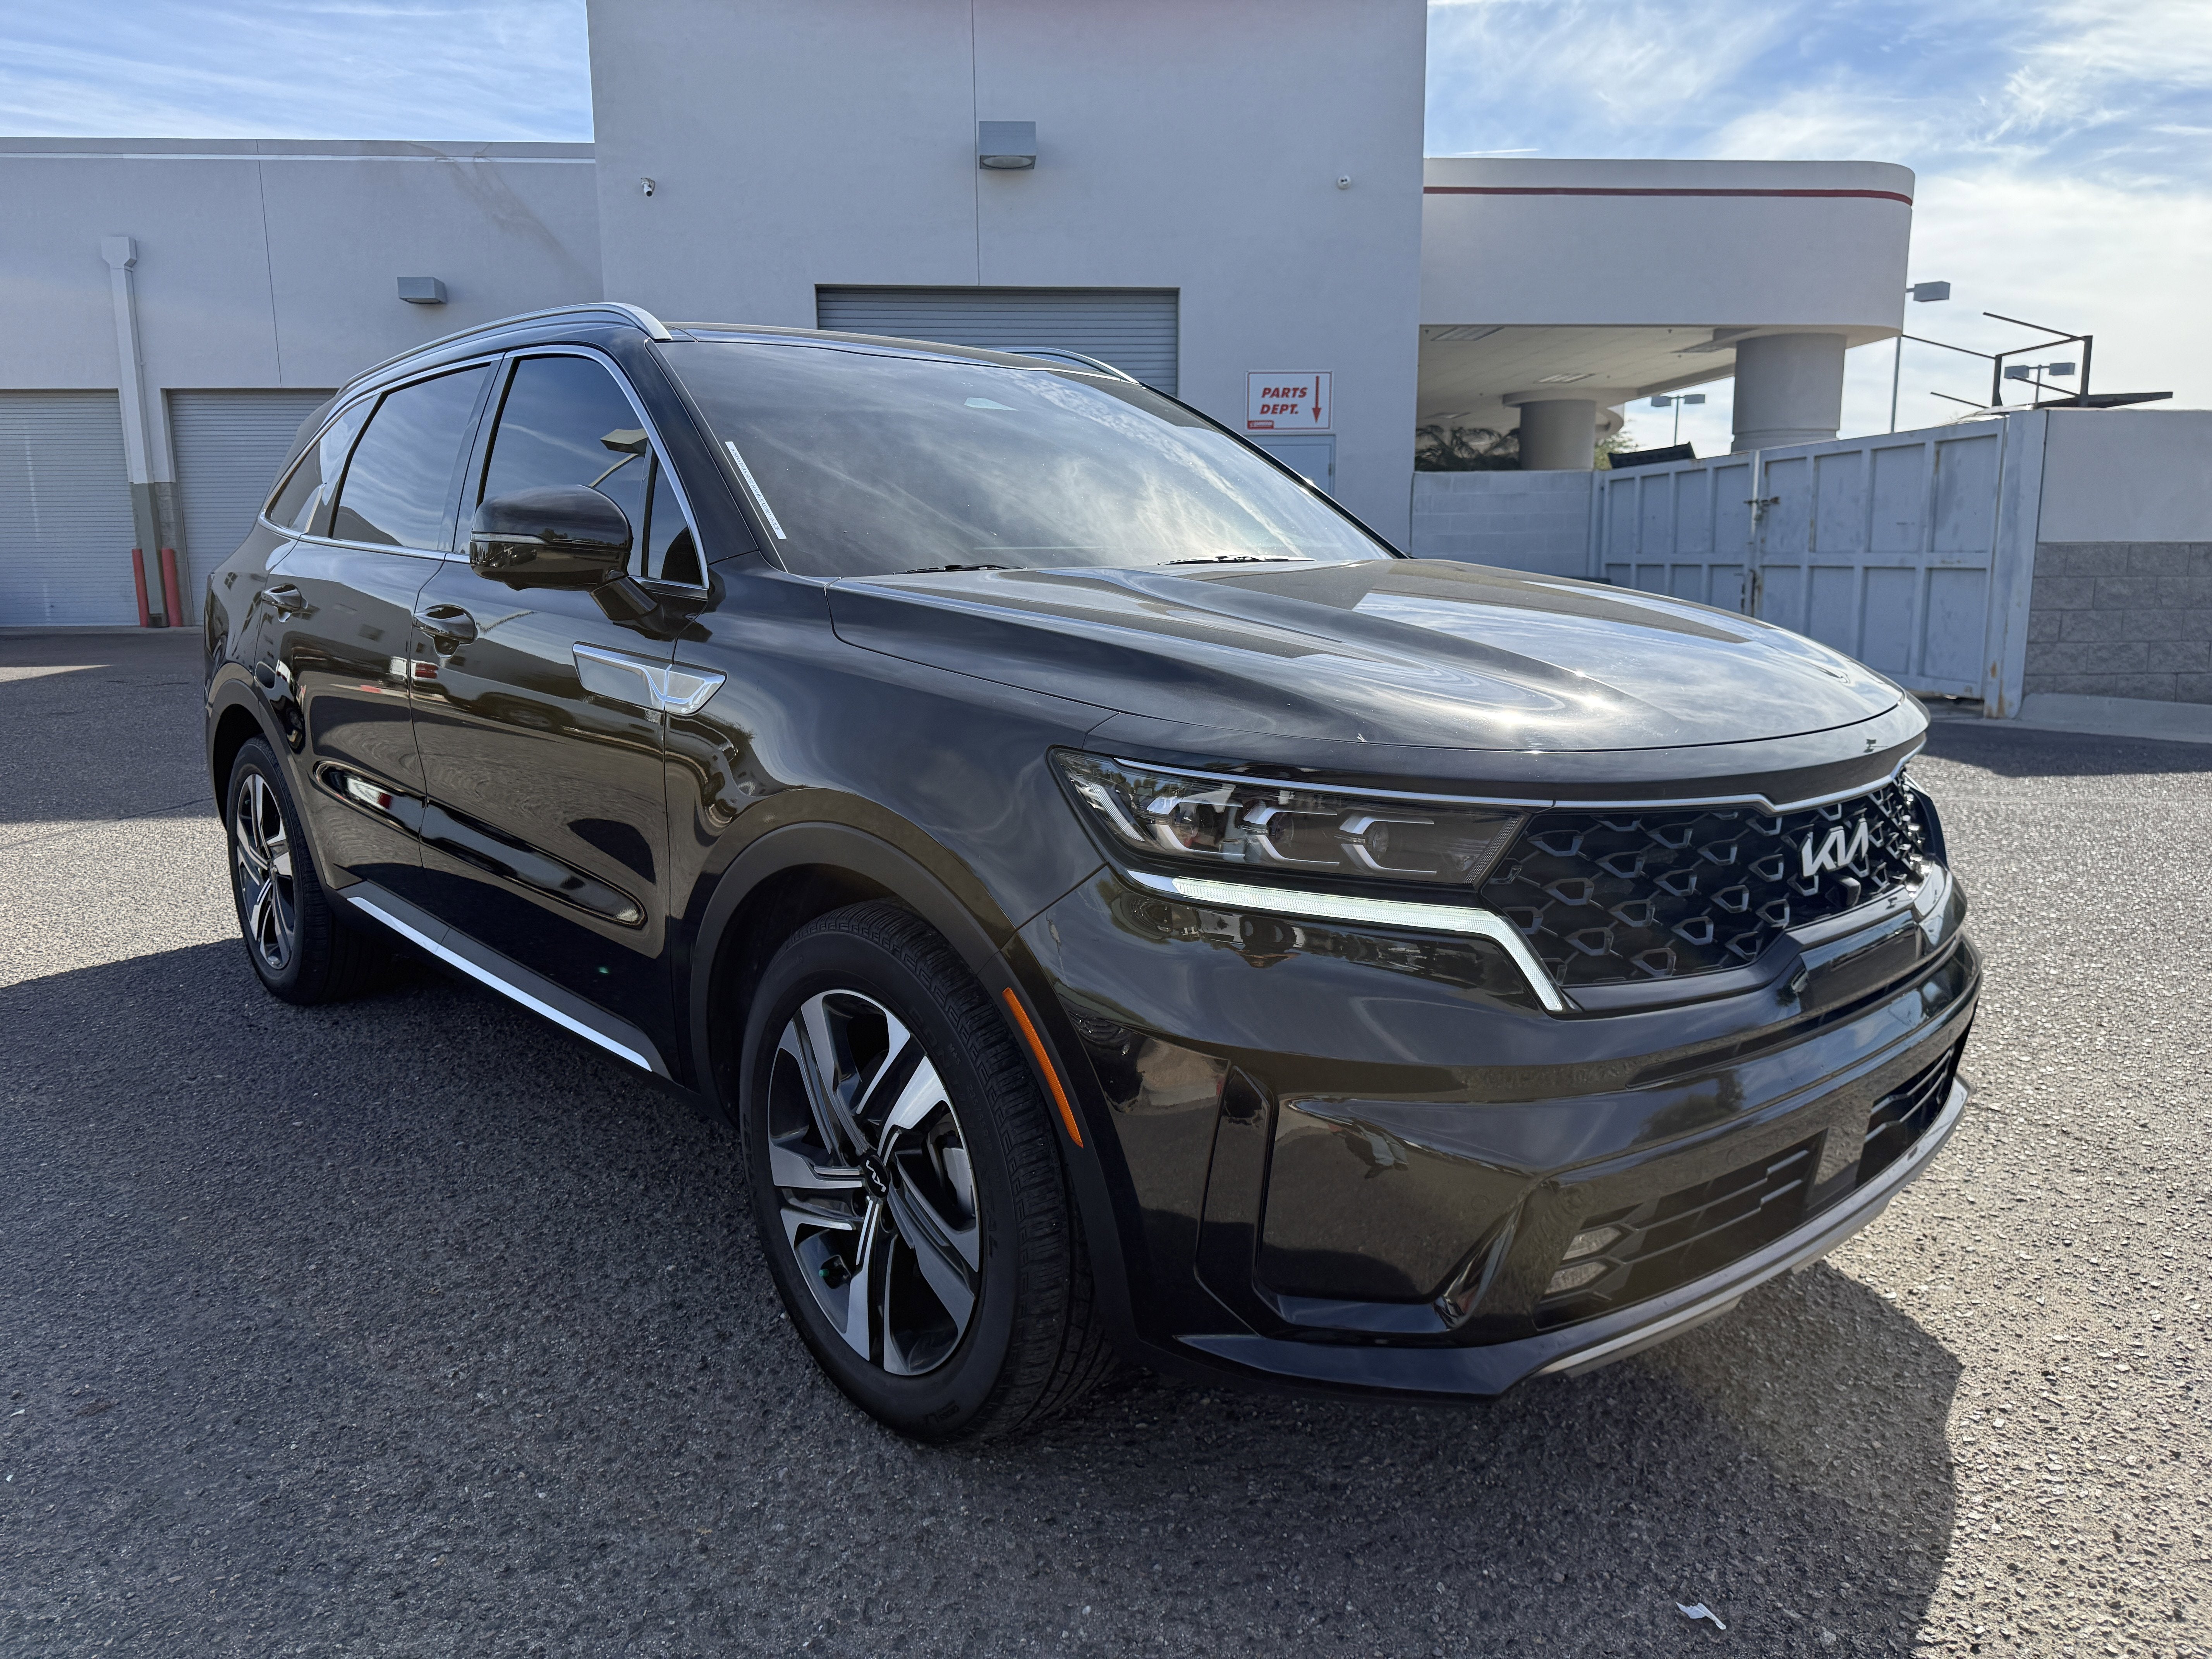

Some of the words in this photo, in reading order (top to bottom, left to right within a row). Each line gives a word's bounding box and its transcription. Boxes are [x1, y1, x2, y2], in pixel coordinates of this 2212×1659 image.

[1261, 387, 1308, 398] PARTS
[1260, 404, 1299, 414] DEPT.
[910, 1005, 998, 1259] CONTINENTAL
